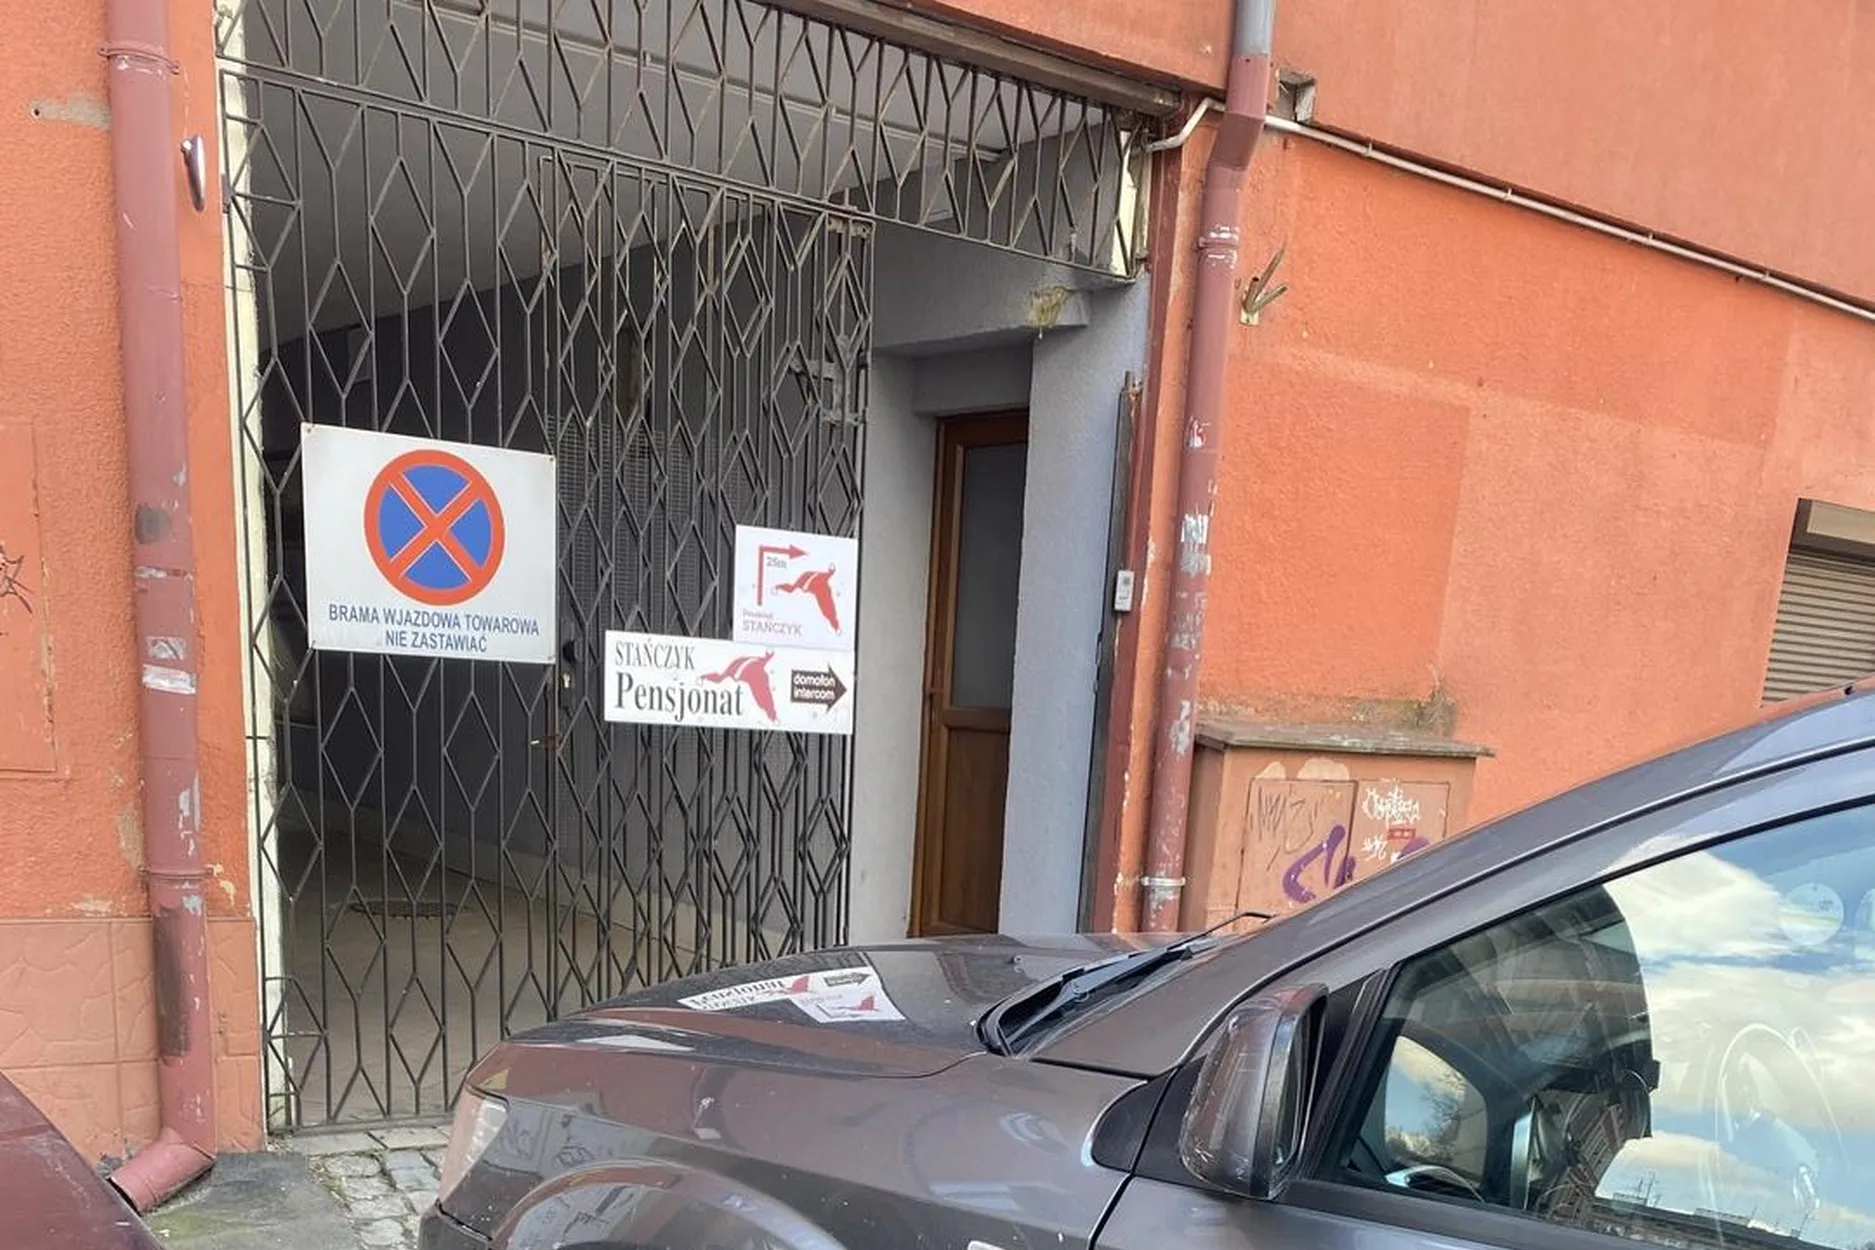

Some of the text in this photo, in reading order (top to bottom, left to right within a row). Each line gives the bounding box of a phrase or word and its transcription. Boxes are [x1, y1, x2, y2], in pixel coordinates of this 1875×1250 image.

[328, 603, 540, 636] BRAMA WJAZDOWA TOWAROWA
[385, 630, 488, 653] NIE ZASTAWIAĆ
[614, 637, 696, 670] STAŃCZYK
[794, 673, 836, 688] domofon
[794, 685, 836, 701] intercom
[615, 671, 744, 722] Pensjonat
